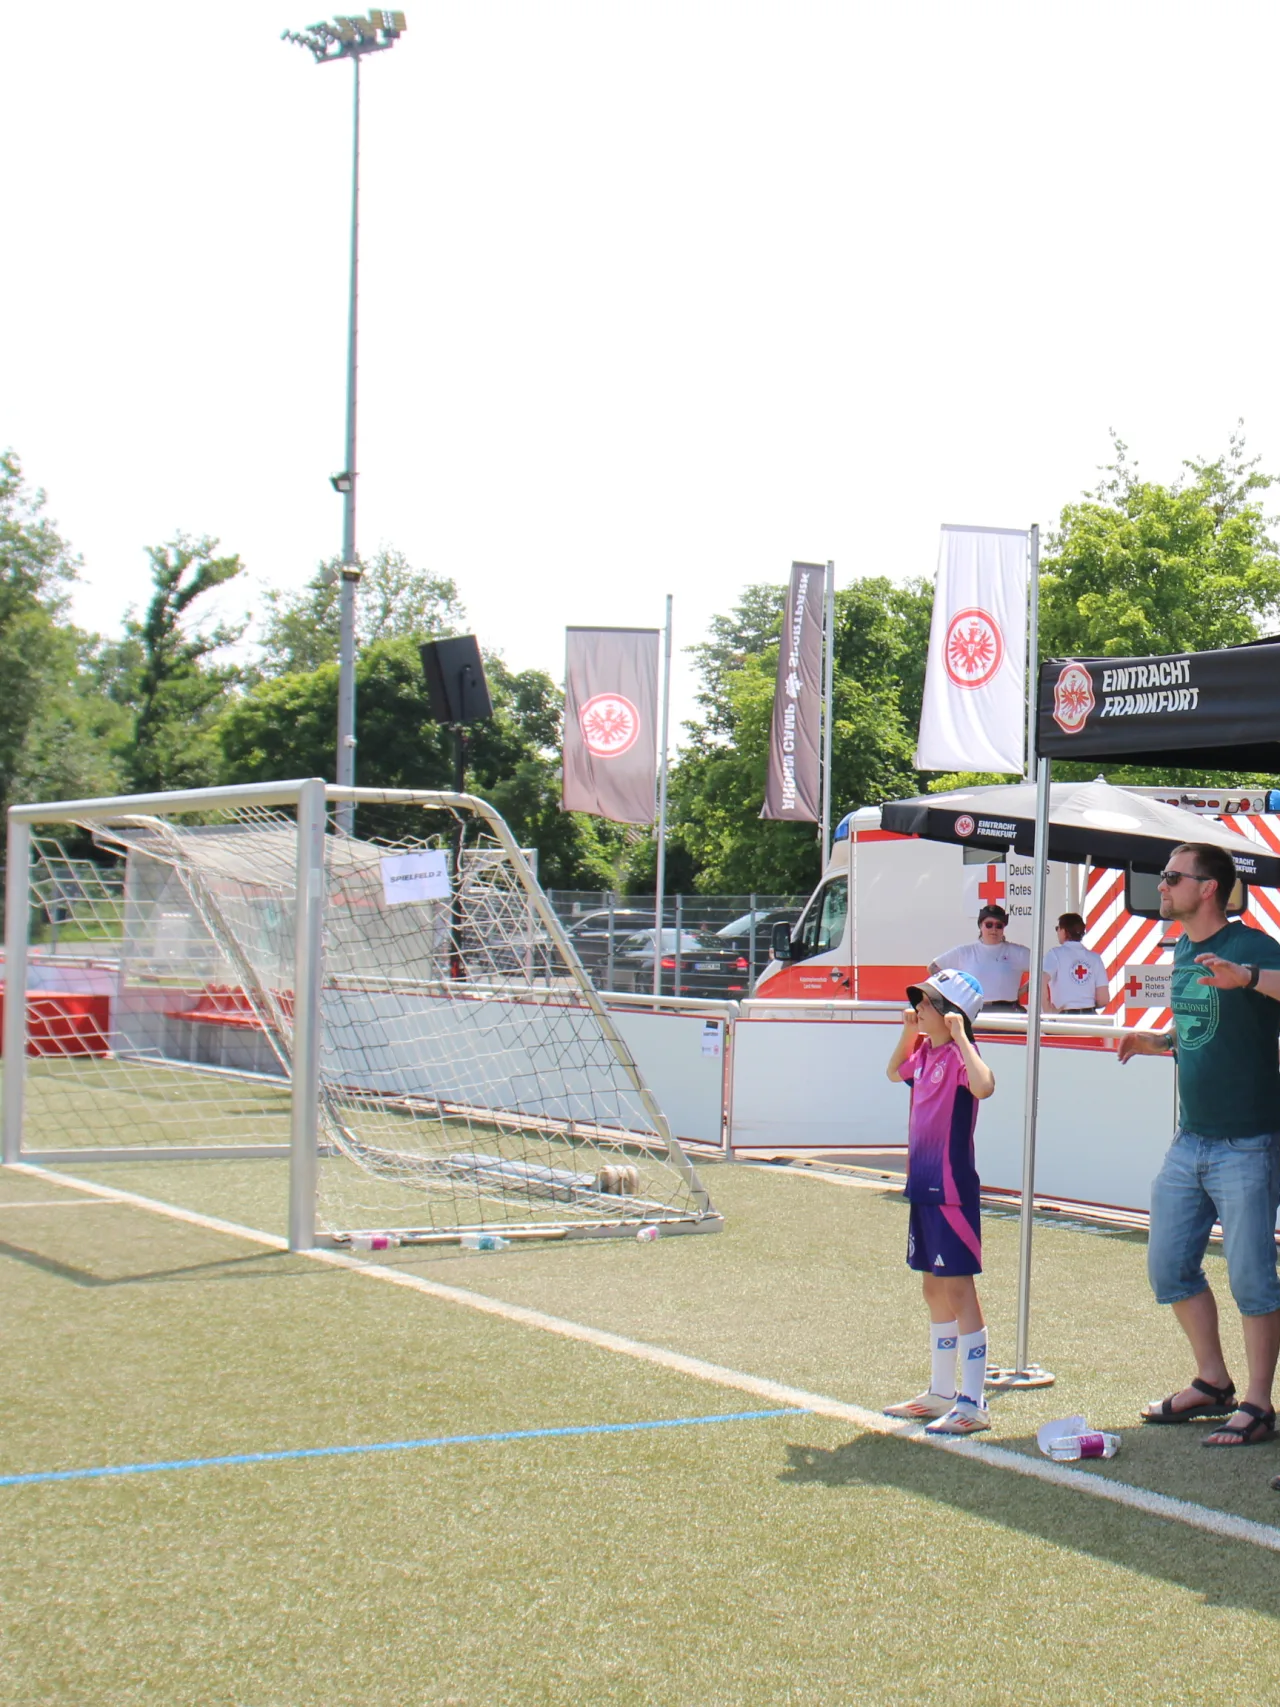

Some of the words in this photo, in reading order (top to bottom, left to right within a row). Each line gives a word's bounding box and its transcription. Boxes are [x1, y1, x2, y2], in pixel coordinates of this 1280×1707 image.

[1102, 659, 1191, 693] EINTRACHT
[1100, 687, 1200, 718] FRANKFURT
[978, 820, 1017, 831] EINTRACHT
[976, 827, 1018, 839] FRANKFURT
[1232, 856, 1255, 867] TRACHT
[1009, 864, 1051, 877] Deutss
[390, 871, 435, 884] SPIELFELD
[436, 870, 443, 878] 2
[1009, 883, 1032, 896] Rotes
[1009, 904, 1033, 916] Kreuz
[1144, 974, 1173, 983] Deutsch
[1144, 983, 1166, 991] Rotes
